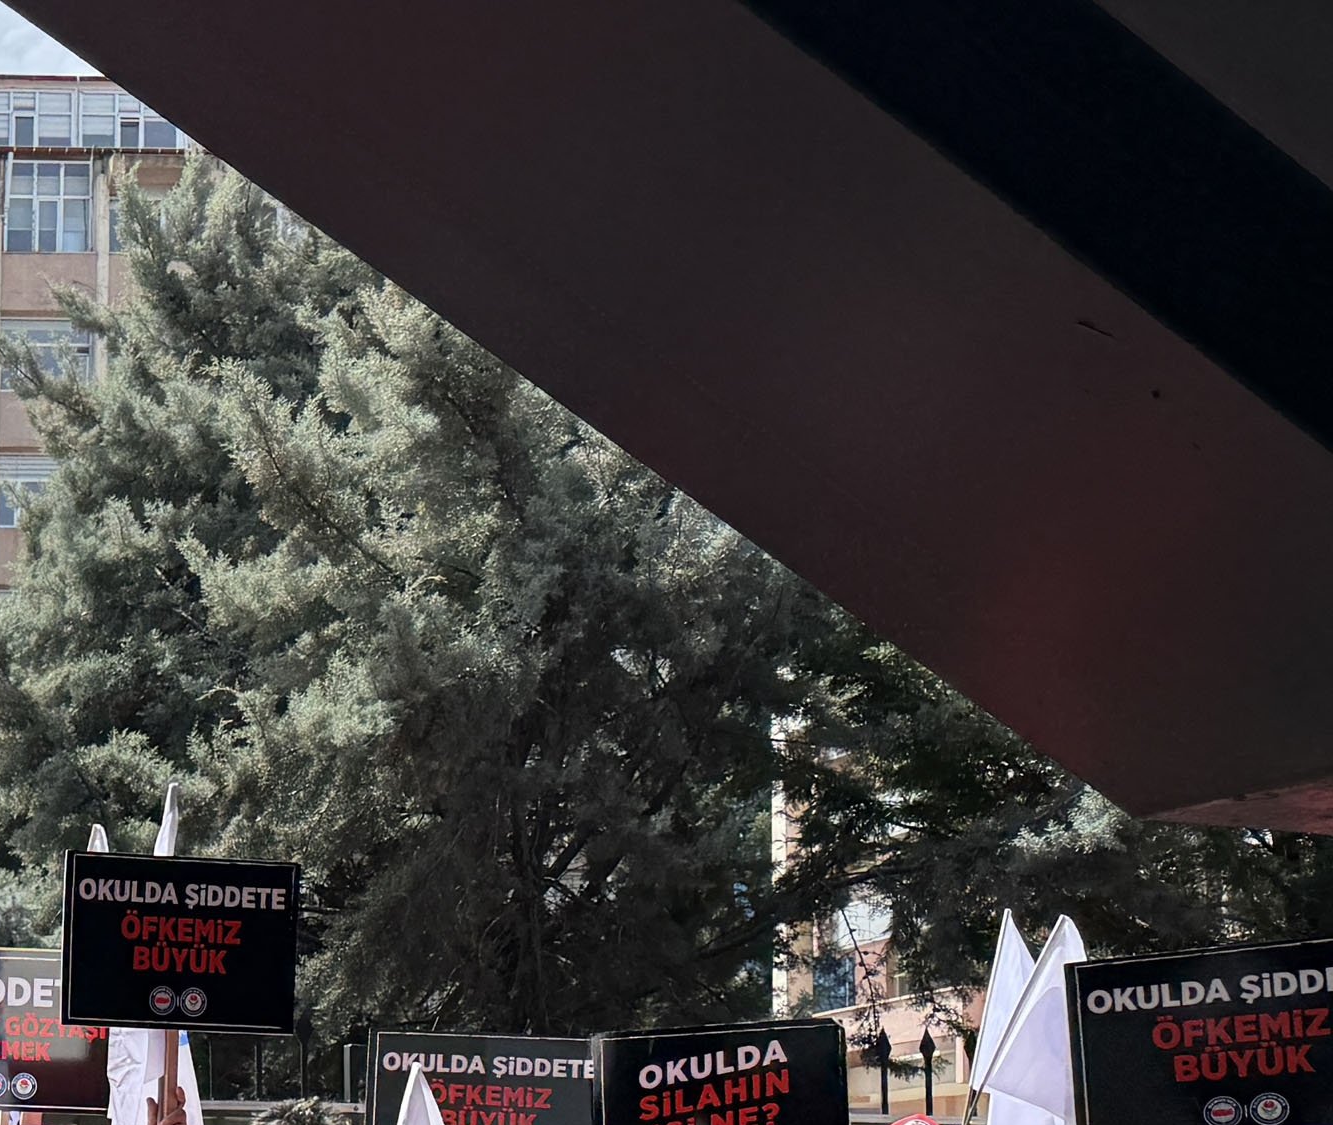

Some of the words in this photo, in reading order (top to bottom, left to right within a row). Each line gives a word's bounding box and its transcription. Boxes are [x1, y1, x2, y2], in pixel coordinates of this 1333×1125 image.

[79, 878, 178, 905] OKULDA
[184, 883, 286, 910] ŞİDDETE
[121, 909, 242, 945] ÖFKEMİZ
[133, 942, 227, 975] BÜYÜK
[1087, 978, 1232, 1015] OKULDA
[1152, 1008, 1331, 1050] ÖFKEMİZ
[382, 1051, 486, 1074] OKULDA
[492, 1056, 594, 1079] ŞİDDETE
[638, 1039, 788, 1089] OKULDA
[1174, 1041, 1316, 1083] BÜYÜK
[432, 1079, 553, 1109] ÖFKEMİZ
[638, 1068, 790, 1121] SİLAHIN
